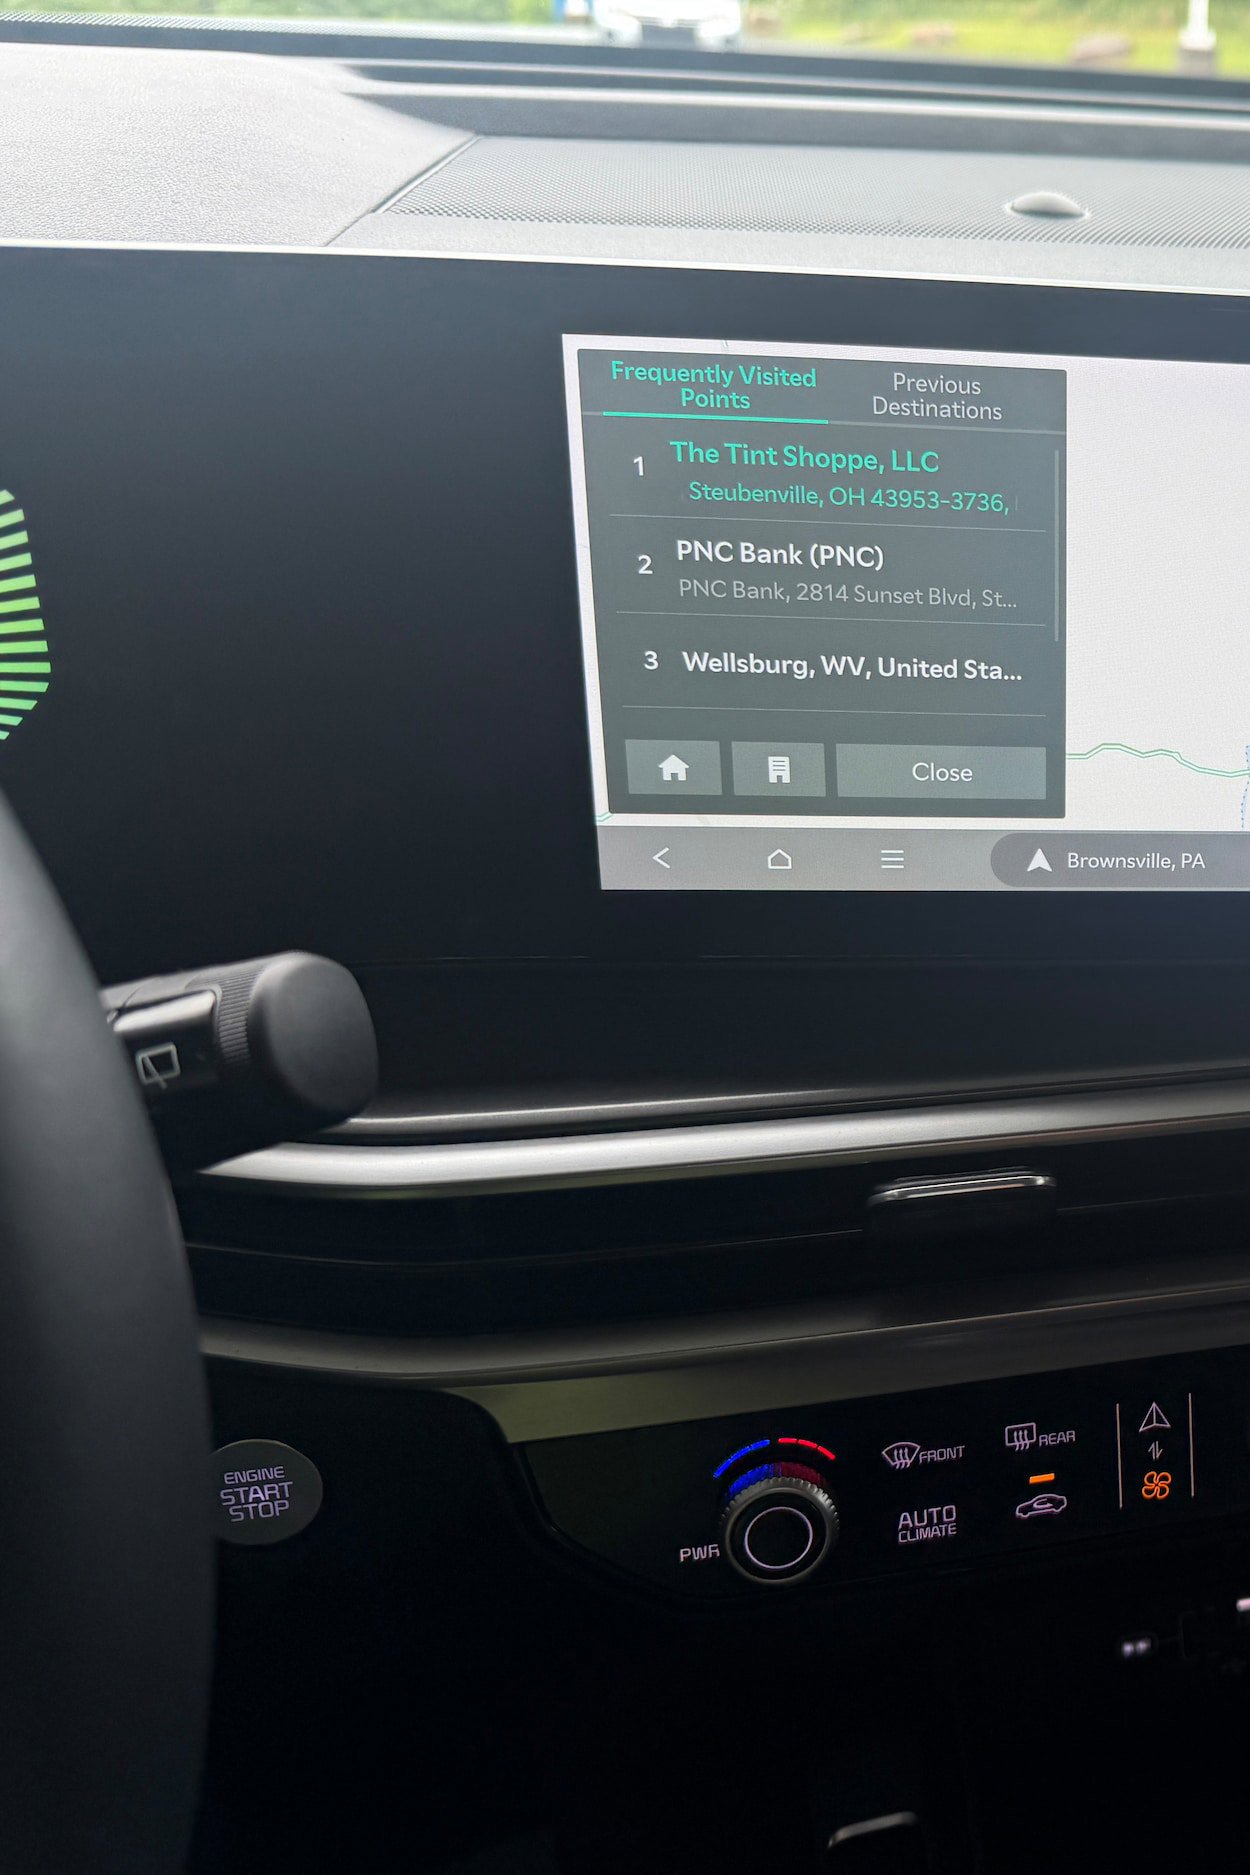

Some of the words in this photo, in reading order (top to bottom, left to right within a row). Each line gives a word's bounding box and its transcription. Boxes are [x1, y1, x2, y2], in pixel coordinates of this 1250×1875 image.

[611, 360, 733, 388] Frequently
[739, 365, 818, 387] Visited
[893, 373, 982, 395] Previous
[681, 389, 751, 410] Points
[872, 397, 1003, 421] Destinations
[633, 457, 645, 476] 1
[670, 441, 720, 465] The
[724, 443, 779, 467] Tint
[783, 446, 885, 475] Shoppe,
[891, 450, 940, 473] LLC
[689, 481, 824, 508] Steubenville,
[829, 487, 866, 507] OH
[870, 488, 1009, 516] 43953-3736,
[637, 555, 653, 575] 2
[677, 540, 735, 563] PNC
[740, 542, 803, 566] Bank
[809, 543, 885, 571] (PNC)
[679, 580, 729, 600] PNC
[733, 580, 791, 604] Bank,
[796, 583, 849, 602] 2814
[853, 585, 923, 606] Sunset
[928, 588, 977, 610] Blvd,
[643, 651, 659, 670] 3
[682, 651, 816, 680] Wellsburg,
[820, 655, 872, 680] WV,
[878, 657, 958, 680] United
[911, 762, 974, 783] Close
[1067, 852, 1176, 872] Brownsville,
[1181, 853, 1206, 869] PA
[1038, 1429, 1077, 1447] REAR
[919, 1445, 966, 1465] FRONT
[224, 1466, 285, 1484] ENGINE
[220, 1481, 293, 1506] START
[229, 1500, 289, 1522] STOP
[898, 1505, 957, 1529] AUTO
[898, 1523, 958, 1544] CLIMATE
[679, 1543, 720, 1562] PWR
